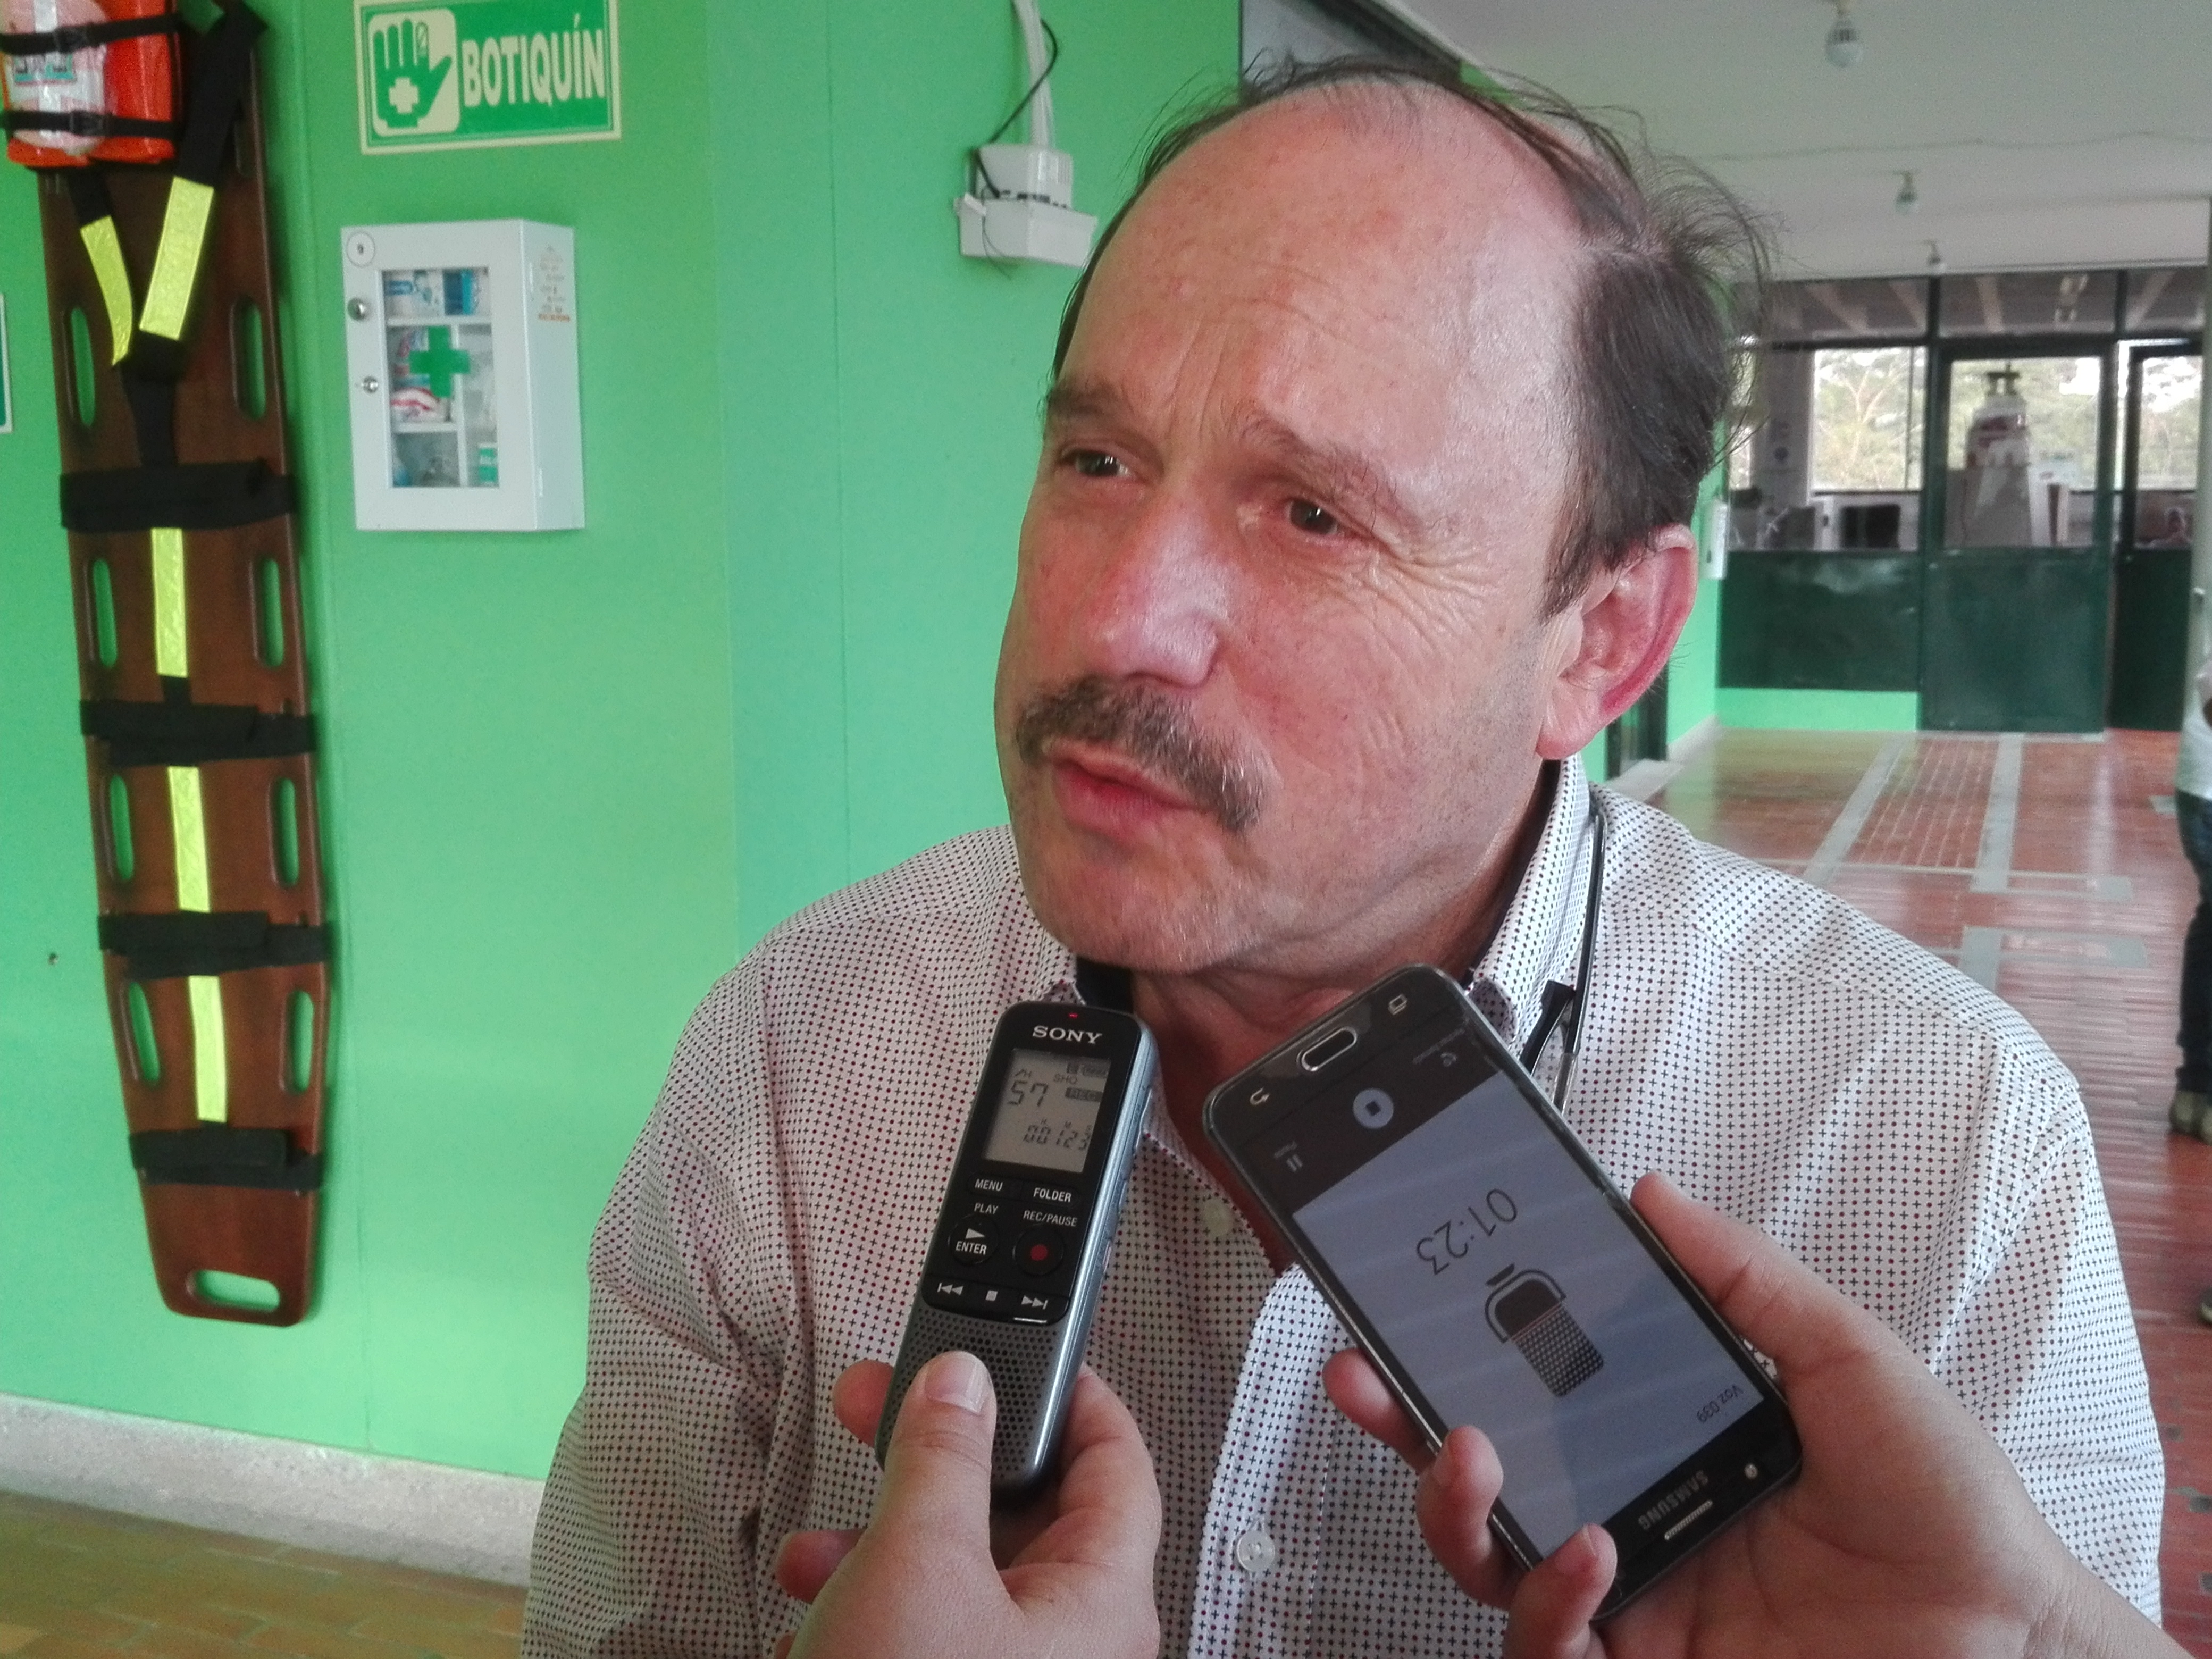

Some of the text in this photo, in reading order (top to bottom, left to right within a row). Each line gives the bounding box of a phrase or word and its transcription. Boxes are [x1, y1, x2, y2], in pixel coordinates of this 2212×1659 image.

[461, 13, 605, 107] BOTIQUÍN
[1032, 1025, 1102, 1044] SONY
[1008, 1079, 1048, 1105] 57
[975, 1178, 1003, 1191] MENU
[1033, 1187, 1071, 1202] FOLDER
[974, 1202, 998, 1214] PLAY
[1023, 1210, 1077, 1226] REC/PAUSE
[1416, 1188, 1518, 1275] 01:23
[955, 1241, 986, 1254] ENTER
[1638, 1470, 1708, 1530] SAMSUNG
